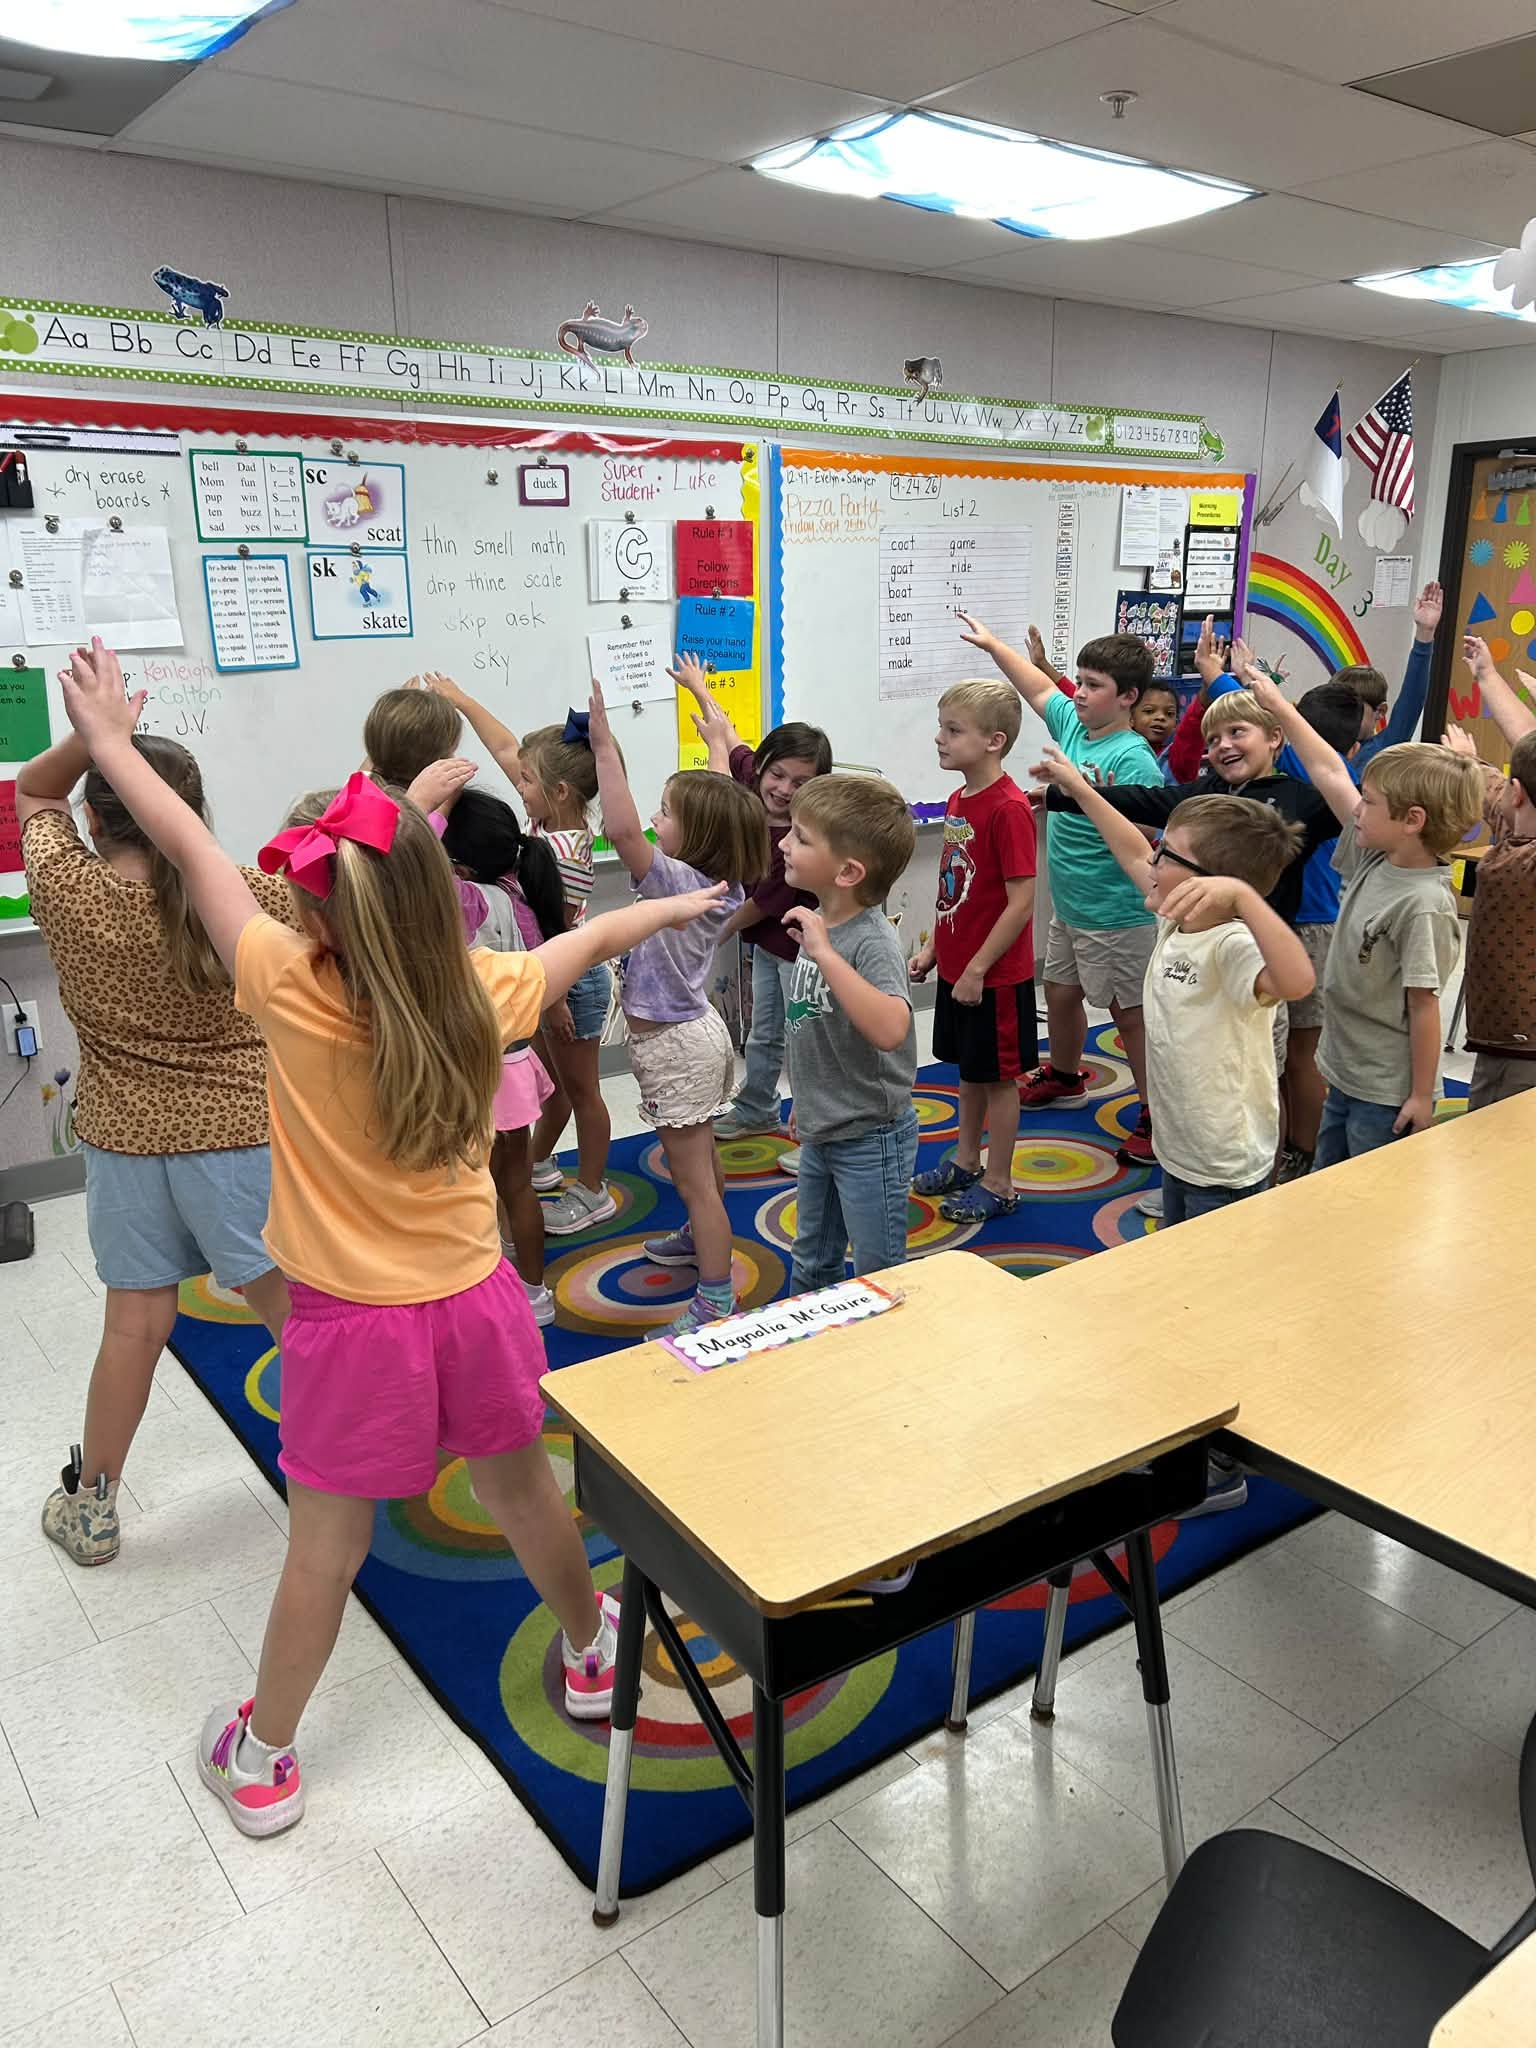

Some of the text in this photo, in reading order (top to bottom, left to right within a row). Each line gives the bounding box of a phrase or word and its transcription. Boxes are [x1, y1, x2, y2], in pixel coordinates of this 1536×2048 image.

[43, 316, 1083, 441] Aa Bb Cc Dd Ee Ff Gg Hh Ii Jj Kk Ll Mm Nn Oo Pp Qq Rr Ss Tt Uu Vv Ww Xx Yy Zz
[202, 462, 219, 471] bell
[237, 462, 256, 472] Dad
[604, 459, 645, 481] Super
[65, 465, 146, 490] dry erase
[200, 477, 224, 486] Mom
[241, 478, 256, 487] fun
[305, 468, 327, 485] sc
[533, 478, 558, 488] duck
[674, 461, 719, 491] Luke
[815, 471, 840, 488] Evelyn
[847, 472, 876, 491] Sawyer
[95, 490, 150, 509] boards
[205, 495, 222, 503] pup
[241, 494, 258, 502] win
[208, 508, 222, 517] ten
[240, 508, 261, 517] buzz
[786, 493, 880, 529] Pizza Party
[943, 497, 980, 517] List 2
[209, 522, 224, 531] sad
[245, 524, 260, 533] yes
[367, 526, 402, 542] scat
[693, 528, 714, 539] Rule
[421, 523, 566, 556] thin smell math
[950, 538, 976, 557] game
[312, 557, 336, 577] sk
[697, 560, 730, 573] Follow
[890, 556, 972, 582] goat ride
[1314, 532, 1353, 590] Day
[427, 565, 562, 597] drip thine scale
[689, 577, 739, 589] Directions
[888, 582, 962, 598] boat to
[695, 604, 716, 616] Rule
[729, 606, 736, 617] 2
[1352, 590, 1373, 617] 3
[363, 611, 408, 629] skate
[444, 600, 546, 638] skip ask
[889, 606, 913, 622] bean
[607, 639, 653, 651] Remember that
[682, 634, 746, 648] Raise your hand
[889, 630, 911, 646] read
[622, 651, 643, 660] follows
[707, 648, 746, 661] Speaking
[888, 654, 913, 669] made
[473, 644, 510, 687] sky
[627, 661, 643, 669] vowel
[644, 659, 655, 667] and
[143, 658, 214, 692] Kenleigh
[626, 672, 647, 680] follows
[719, 678, 726, 688] #
[729, 677, 736, 687] 3
[10, 684, 25, 695] you
[159, 684, 222, 704] Colton
[16, 696, 26, 704] do
[697, 1294, 872, 1355] Magnolia McGuire
